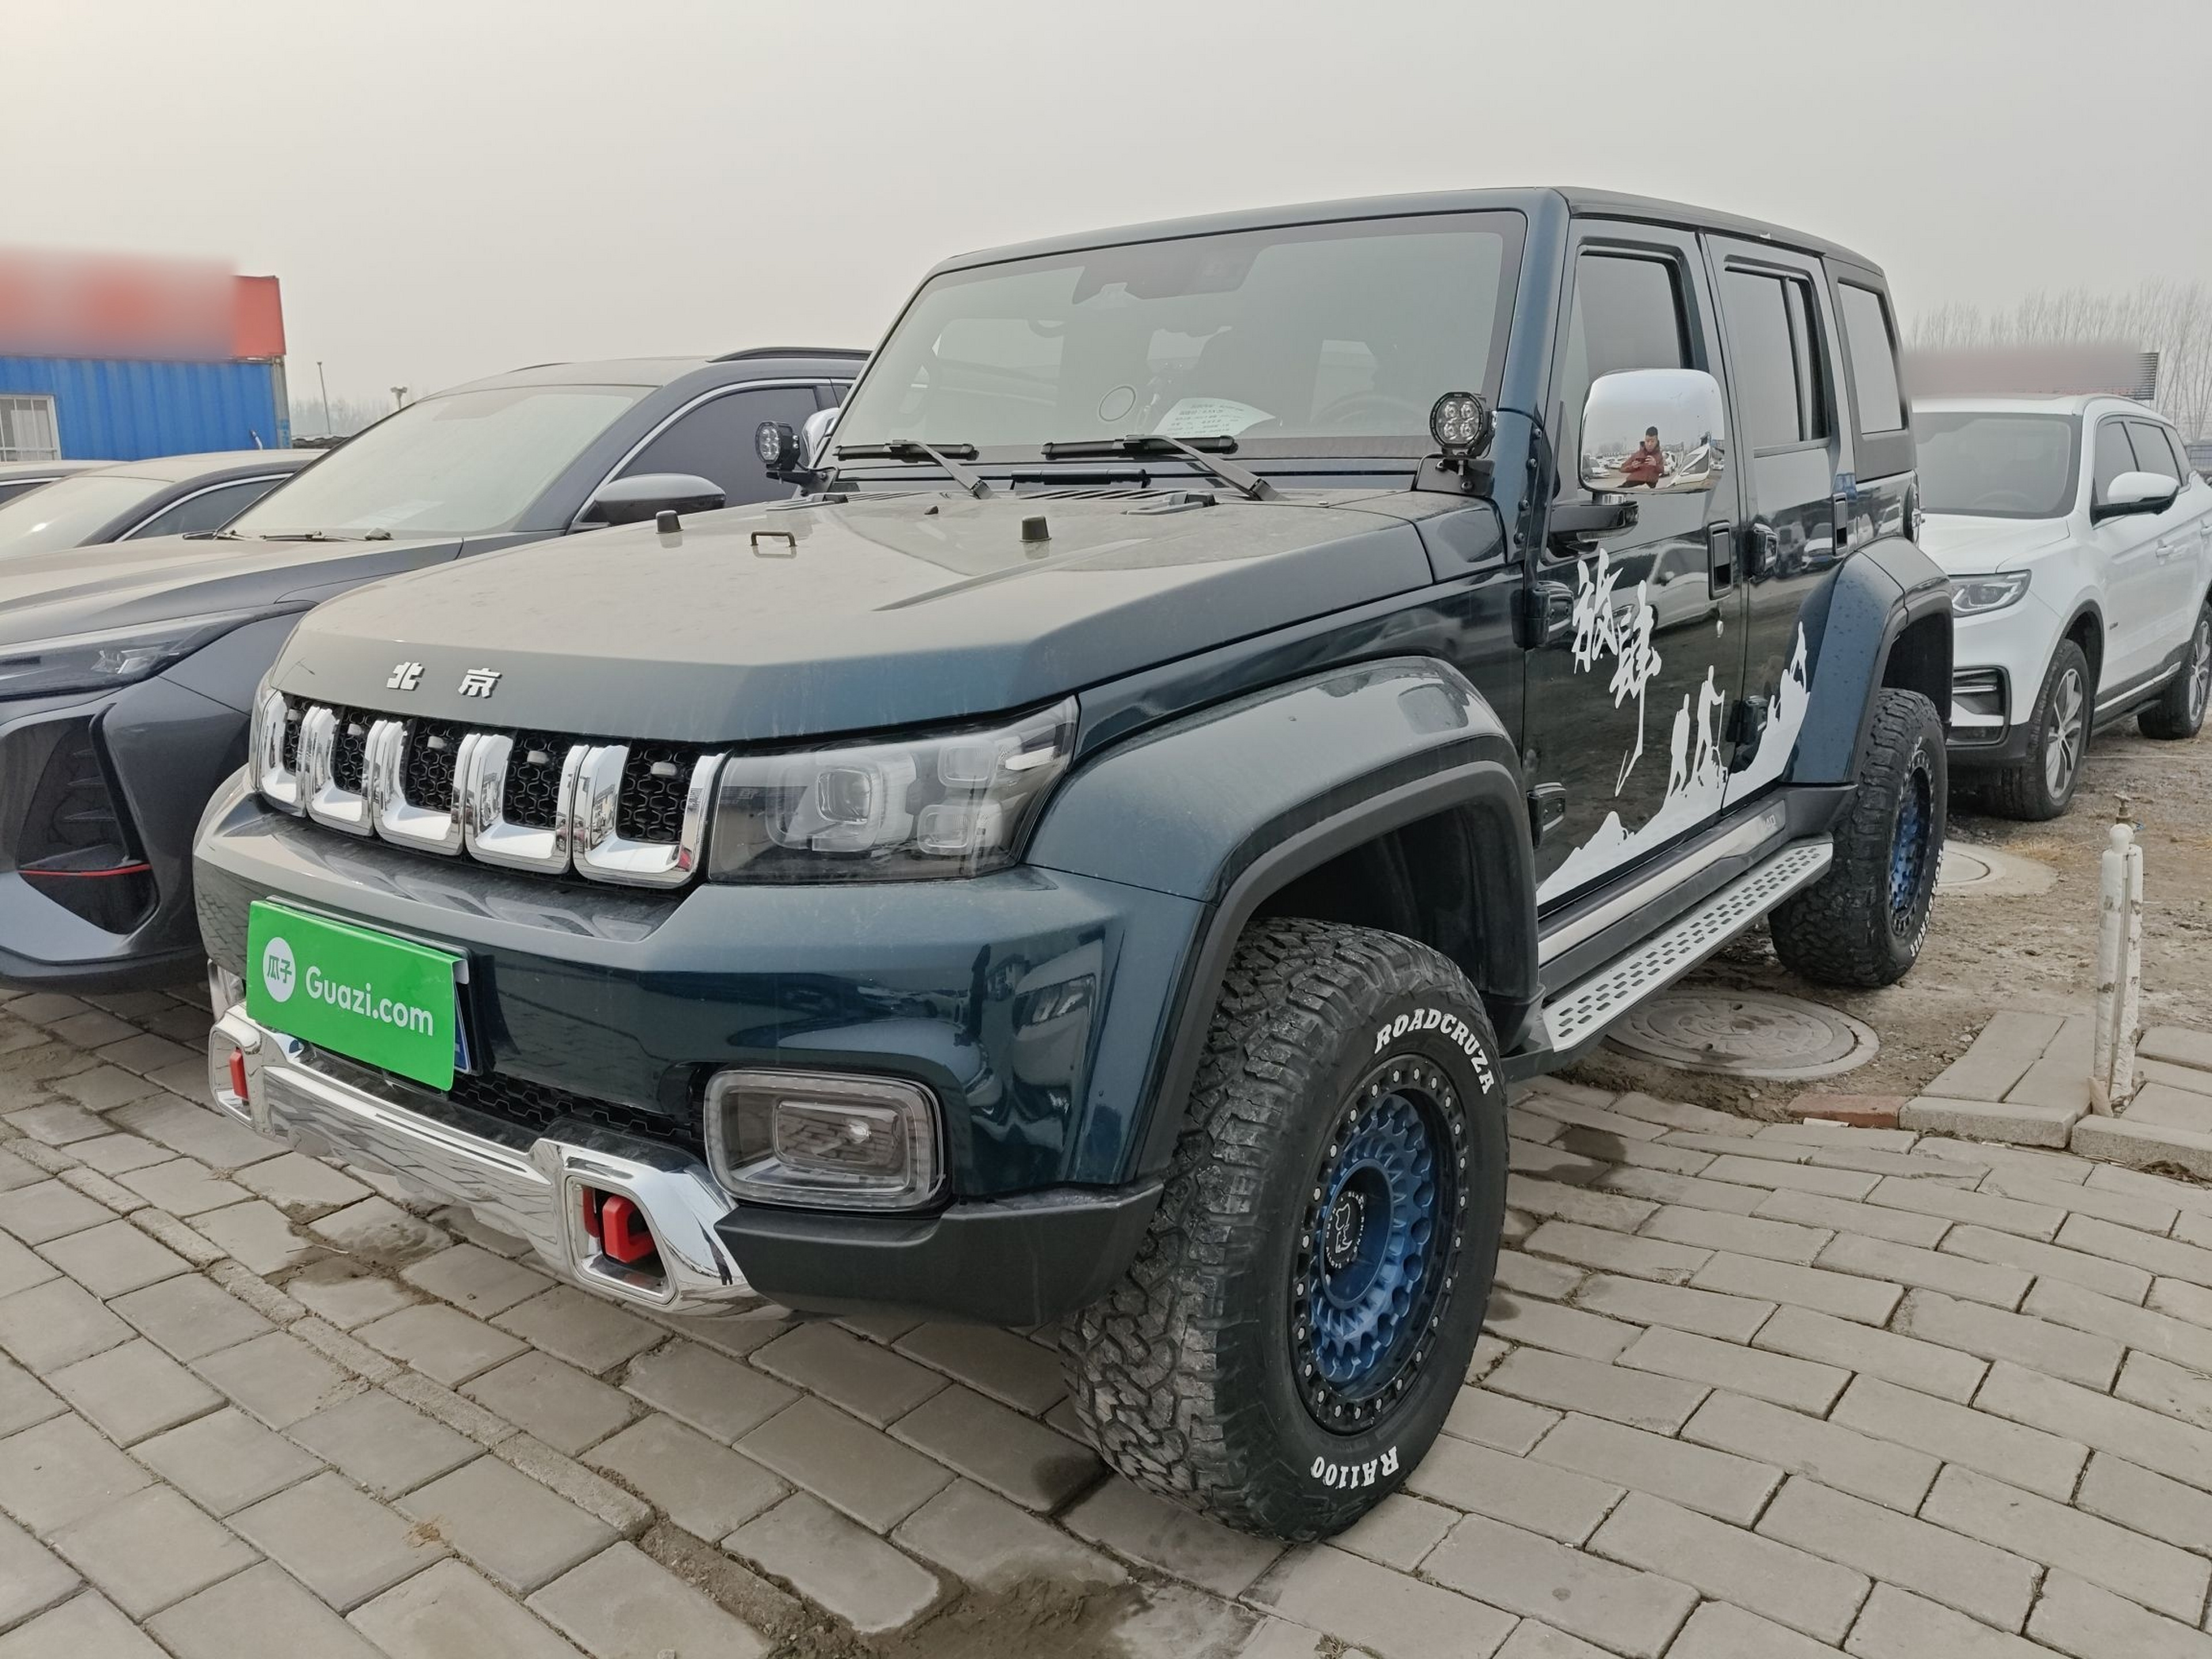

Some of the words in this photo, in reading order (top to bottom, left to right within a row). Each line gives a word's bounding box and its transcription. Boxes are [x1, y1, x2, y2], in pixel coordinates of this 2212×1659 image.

[387, 662, 501, 698] 北京
[267, 955, 292, 983] 瓜子
[305, 966, 433, 1036] Guazi.com
[1374, 1008, 1494, 1094] ROADCRUZA
[1310, 1445, 1399, 1490] RA1100
